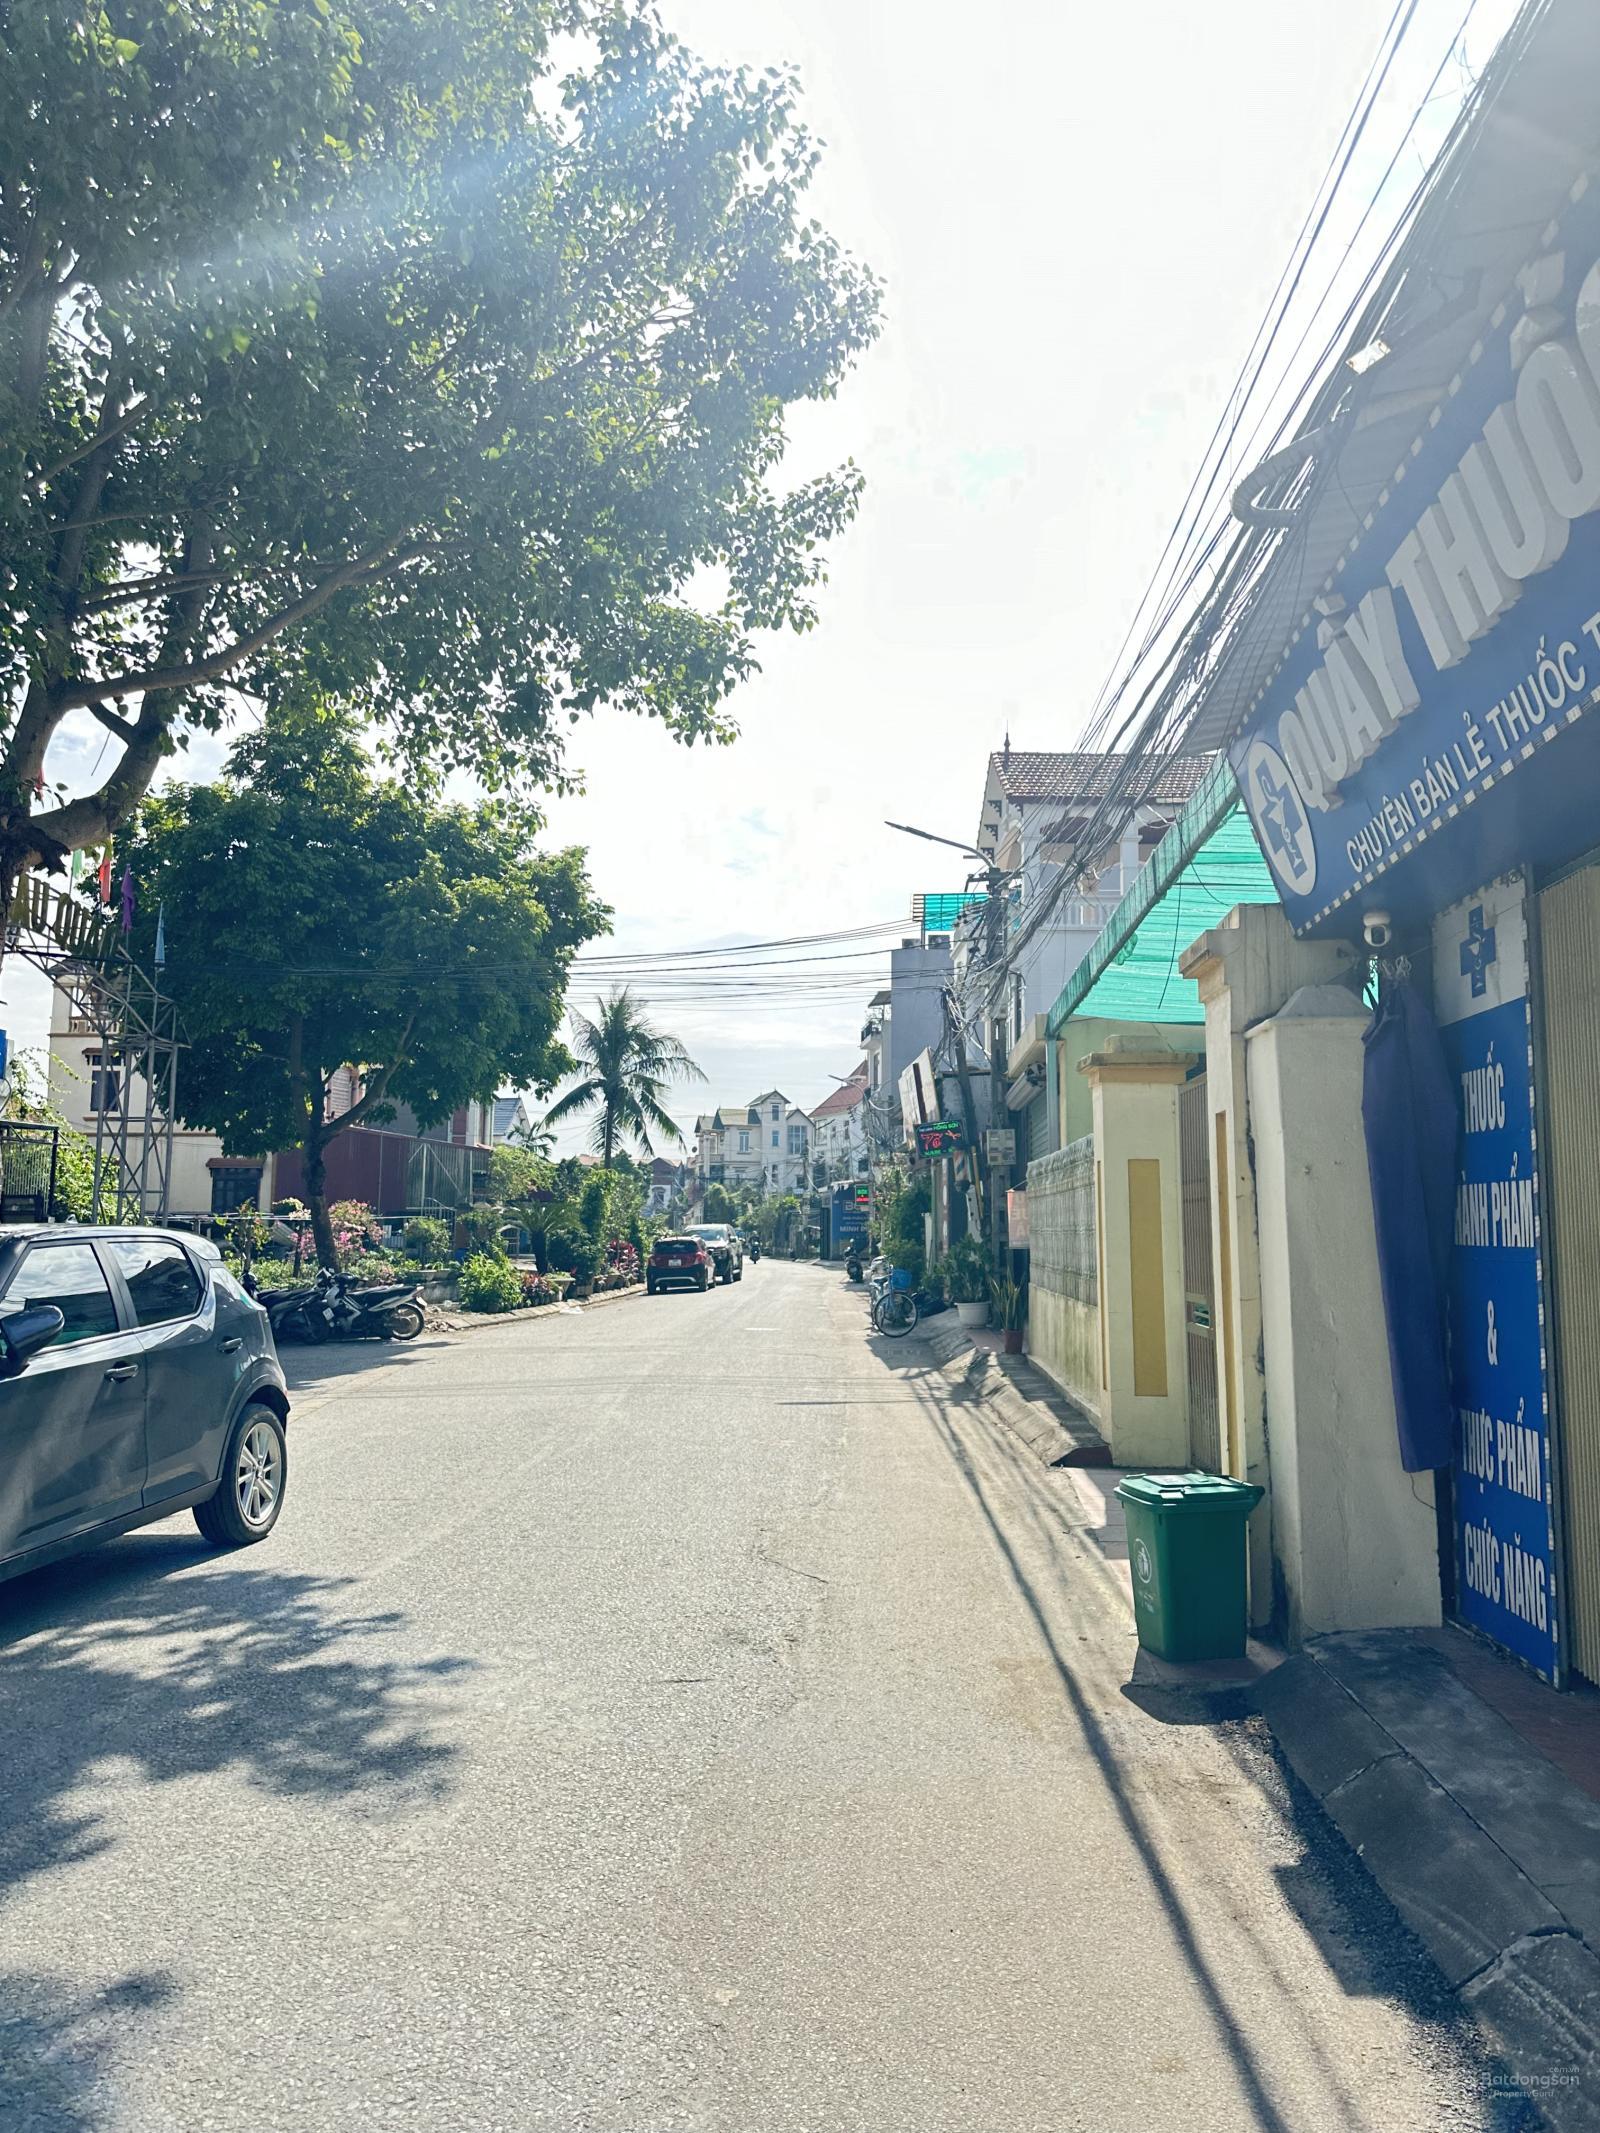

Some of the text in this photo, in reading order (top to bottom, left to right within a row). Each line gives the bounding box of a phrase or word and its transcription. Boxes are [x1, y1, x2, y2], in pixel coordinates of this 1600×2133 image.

[1279, 586, 1418, 814] QUẦY
[1346, 634, 1586, 873] CHUYÊN BÁN LẺ THUỐC
[1461, 1041, 1506, 1133] THUỐC
[1455, 1152, 1535, 1248] HÀNH PHẨM
[1487, 1300, 1498, 1366] &
[1460, 1397, 1542, 1502] THỰC PHẨM
[1464, 1517, 1548, 1633] CHỨC NĂNG
